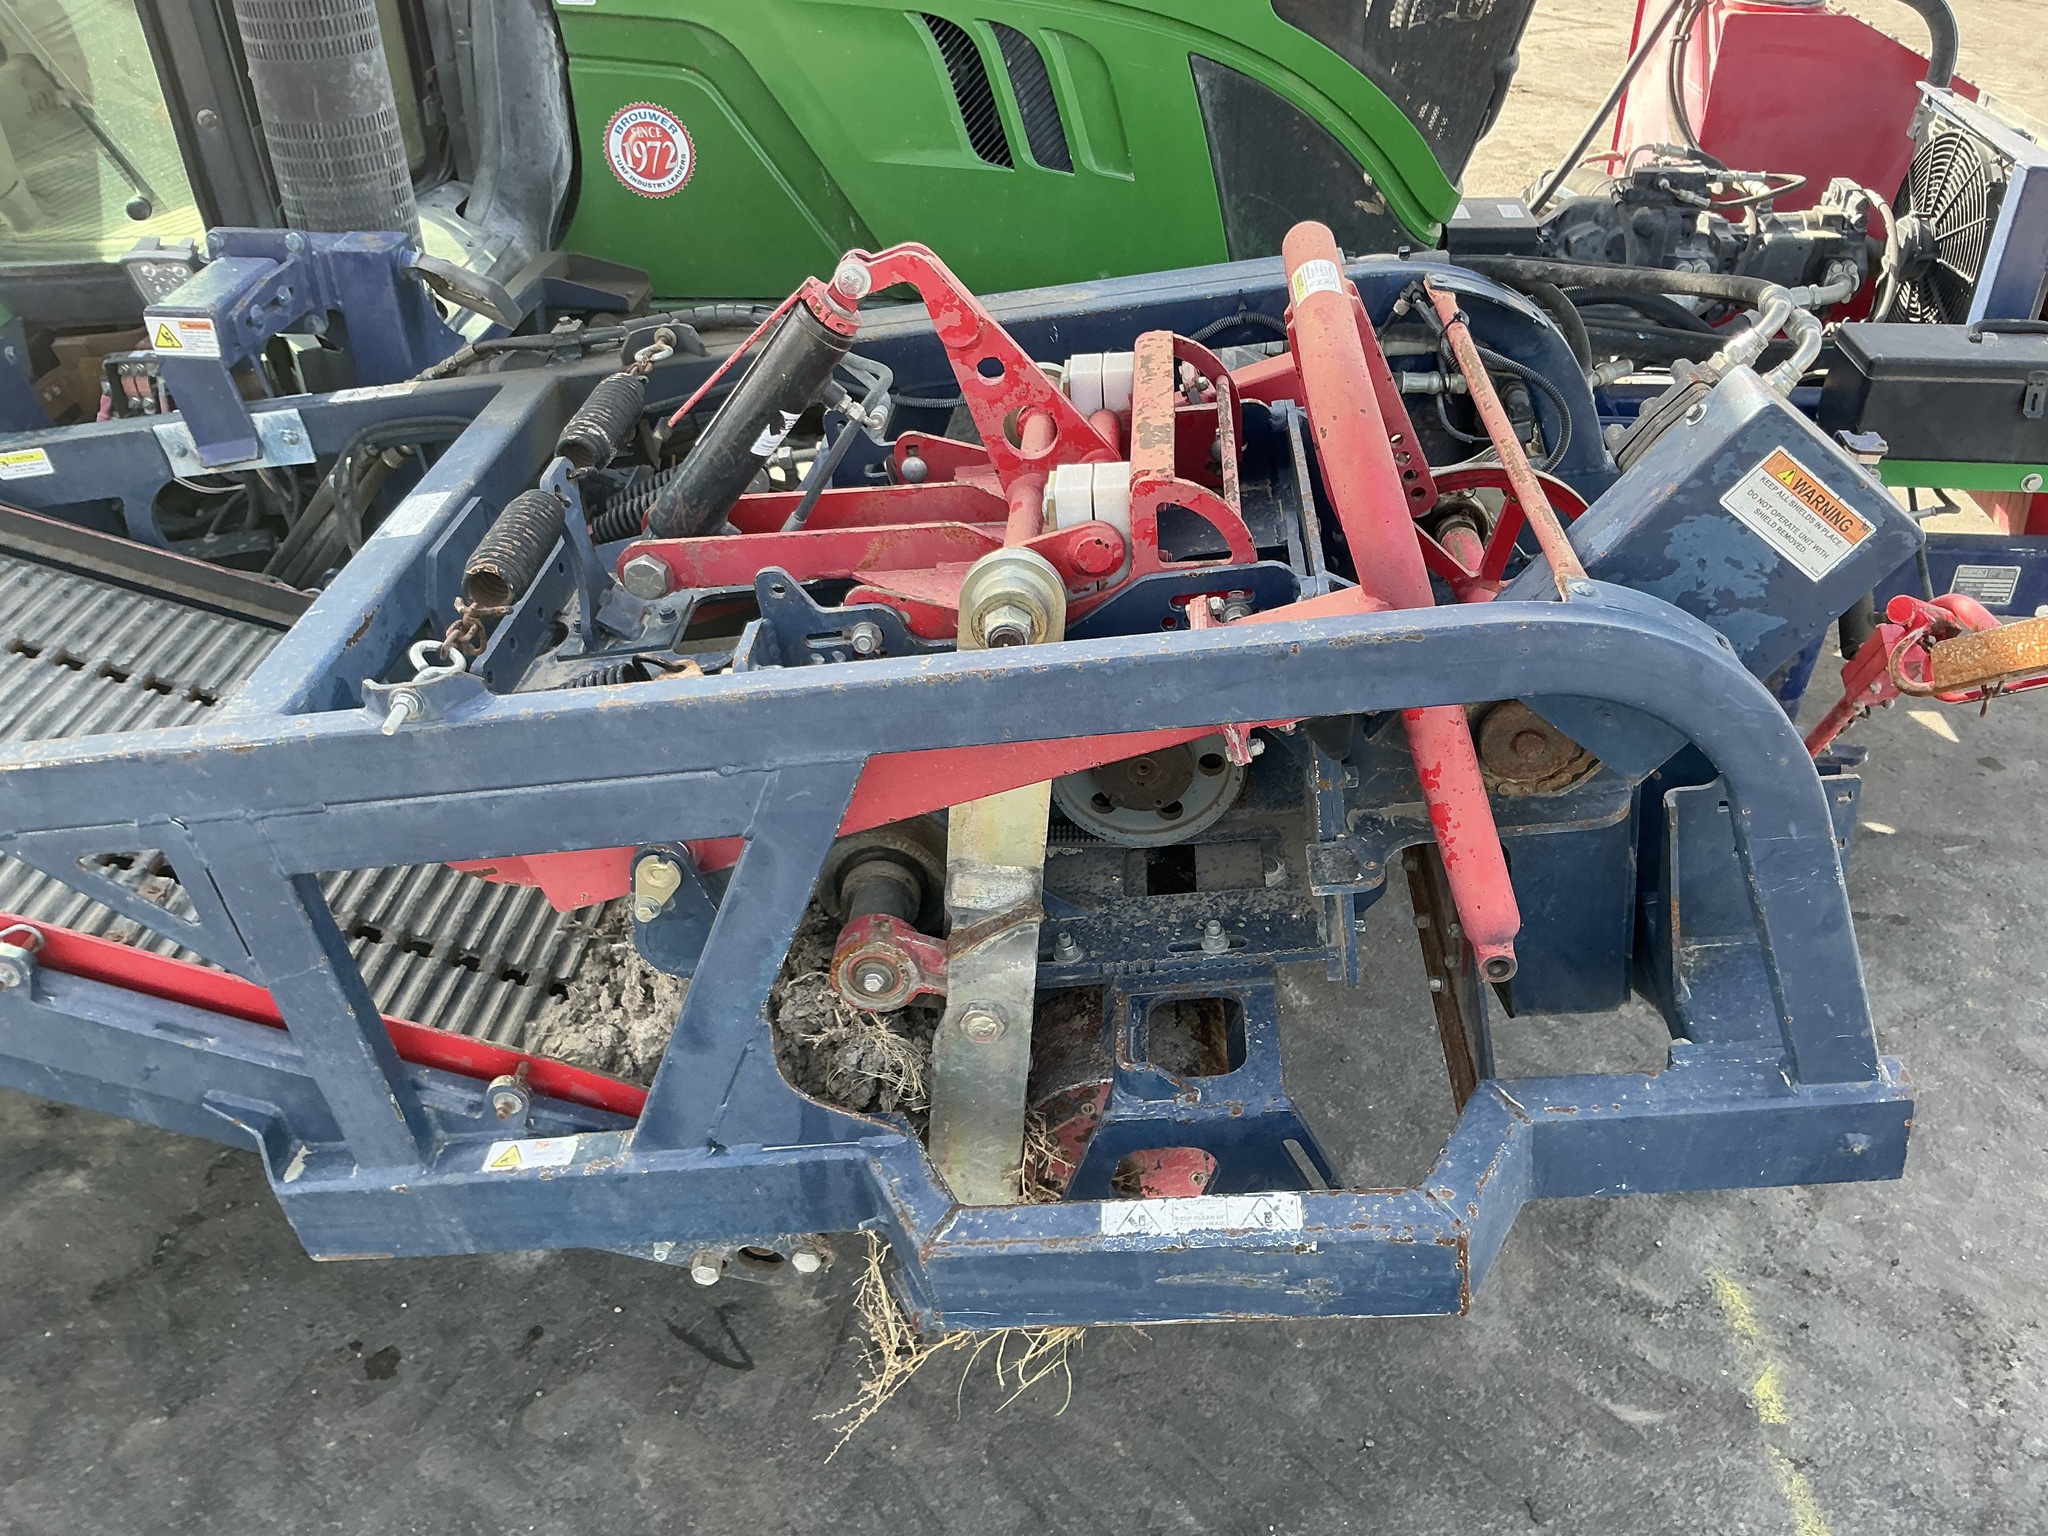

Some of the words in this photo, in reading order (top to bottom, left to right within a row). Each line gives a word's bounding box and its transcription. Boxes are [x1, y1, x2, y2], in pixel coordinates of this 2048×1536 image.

[614, 111, 678, 135] BROUWER
[630, 126, 663, 138] SINCE
[614, 153, 629, 175] TURF
[629, 175, 667, 189] INDUSTRY
[667, 153, 687, 185] LEADERS
[622, 141, 678, 174] 1972
[1747, 489, 1758, 501] DO
[1756, 497, 1773, 512] NOT
[1770, 507, 1800, 535] OPERATE
[1798, 531, 1814, 547] UNIT
[1812, 542, 1830, 559] WITH
[1759, 475, 1778, 492] KEEP
[1775, 489, 1790, 502] ALL
[1789, 500, 1816, 525] SHIELDS
[1813, 520, 1822, 530] IN
[1819, 525, 1843, 549] PLACE.
[1792, 477, 1853, 533] WARNING
[1753, 508, 1777, 529] SHIELD
[1775, 526, 1807, 555] REMOVED.
